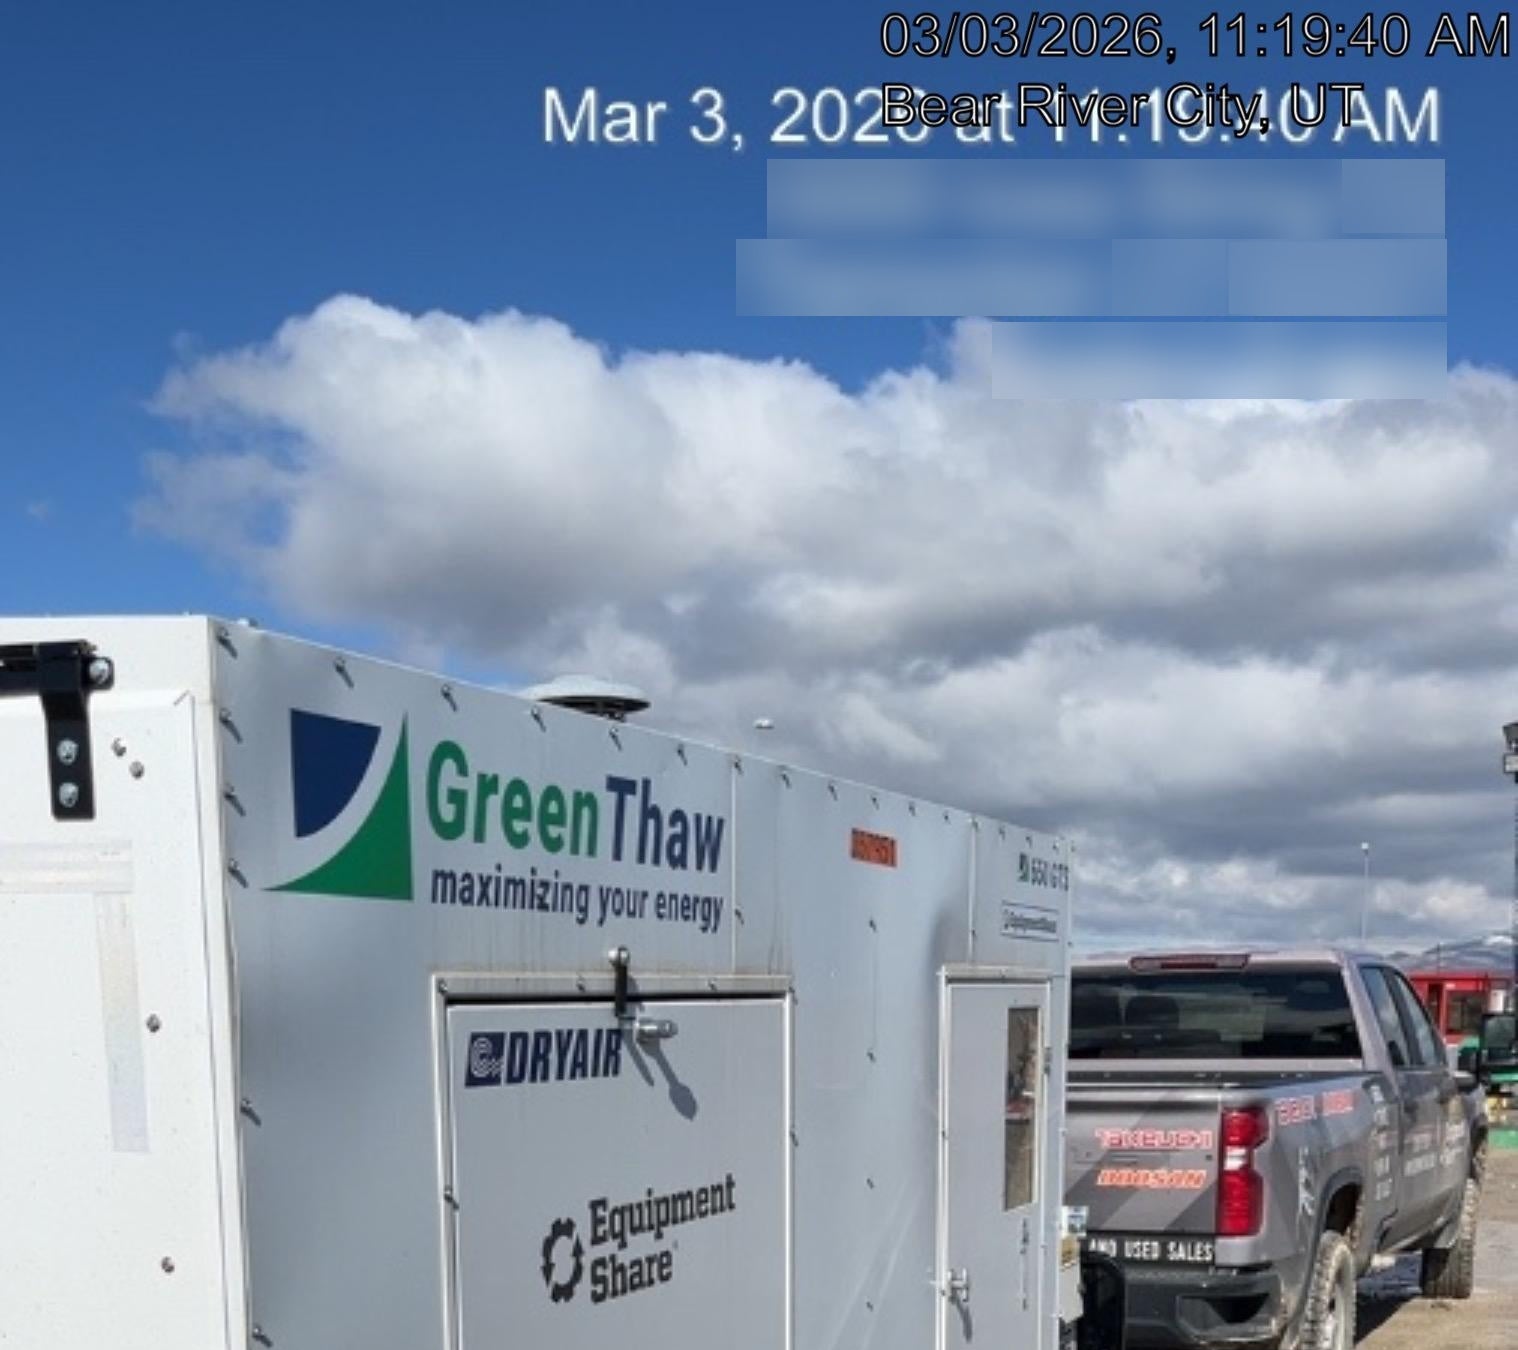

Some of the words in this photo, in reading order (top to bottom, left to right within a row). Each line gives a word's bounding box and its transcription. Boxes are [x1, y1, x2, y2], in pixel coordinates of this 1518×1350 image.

[427, 740, 725, 873] GreenThaw
[430, 863, 590, 926] maximizing
[597, 884, 648, 928] your
[654, 892, 723, 934] energy
[505, 1027, 623, 1085] DRYAIR
[588, 1173, 736, 1250] Equipment
[588, 1249, 673, 1304] Share
[1124, 1241, 1161, 1261] USED
[1166, 1241, 1214, 1263] SALES
